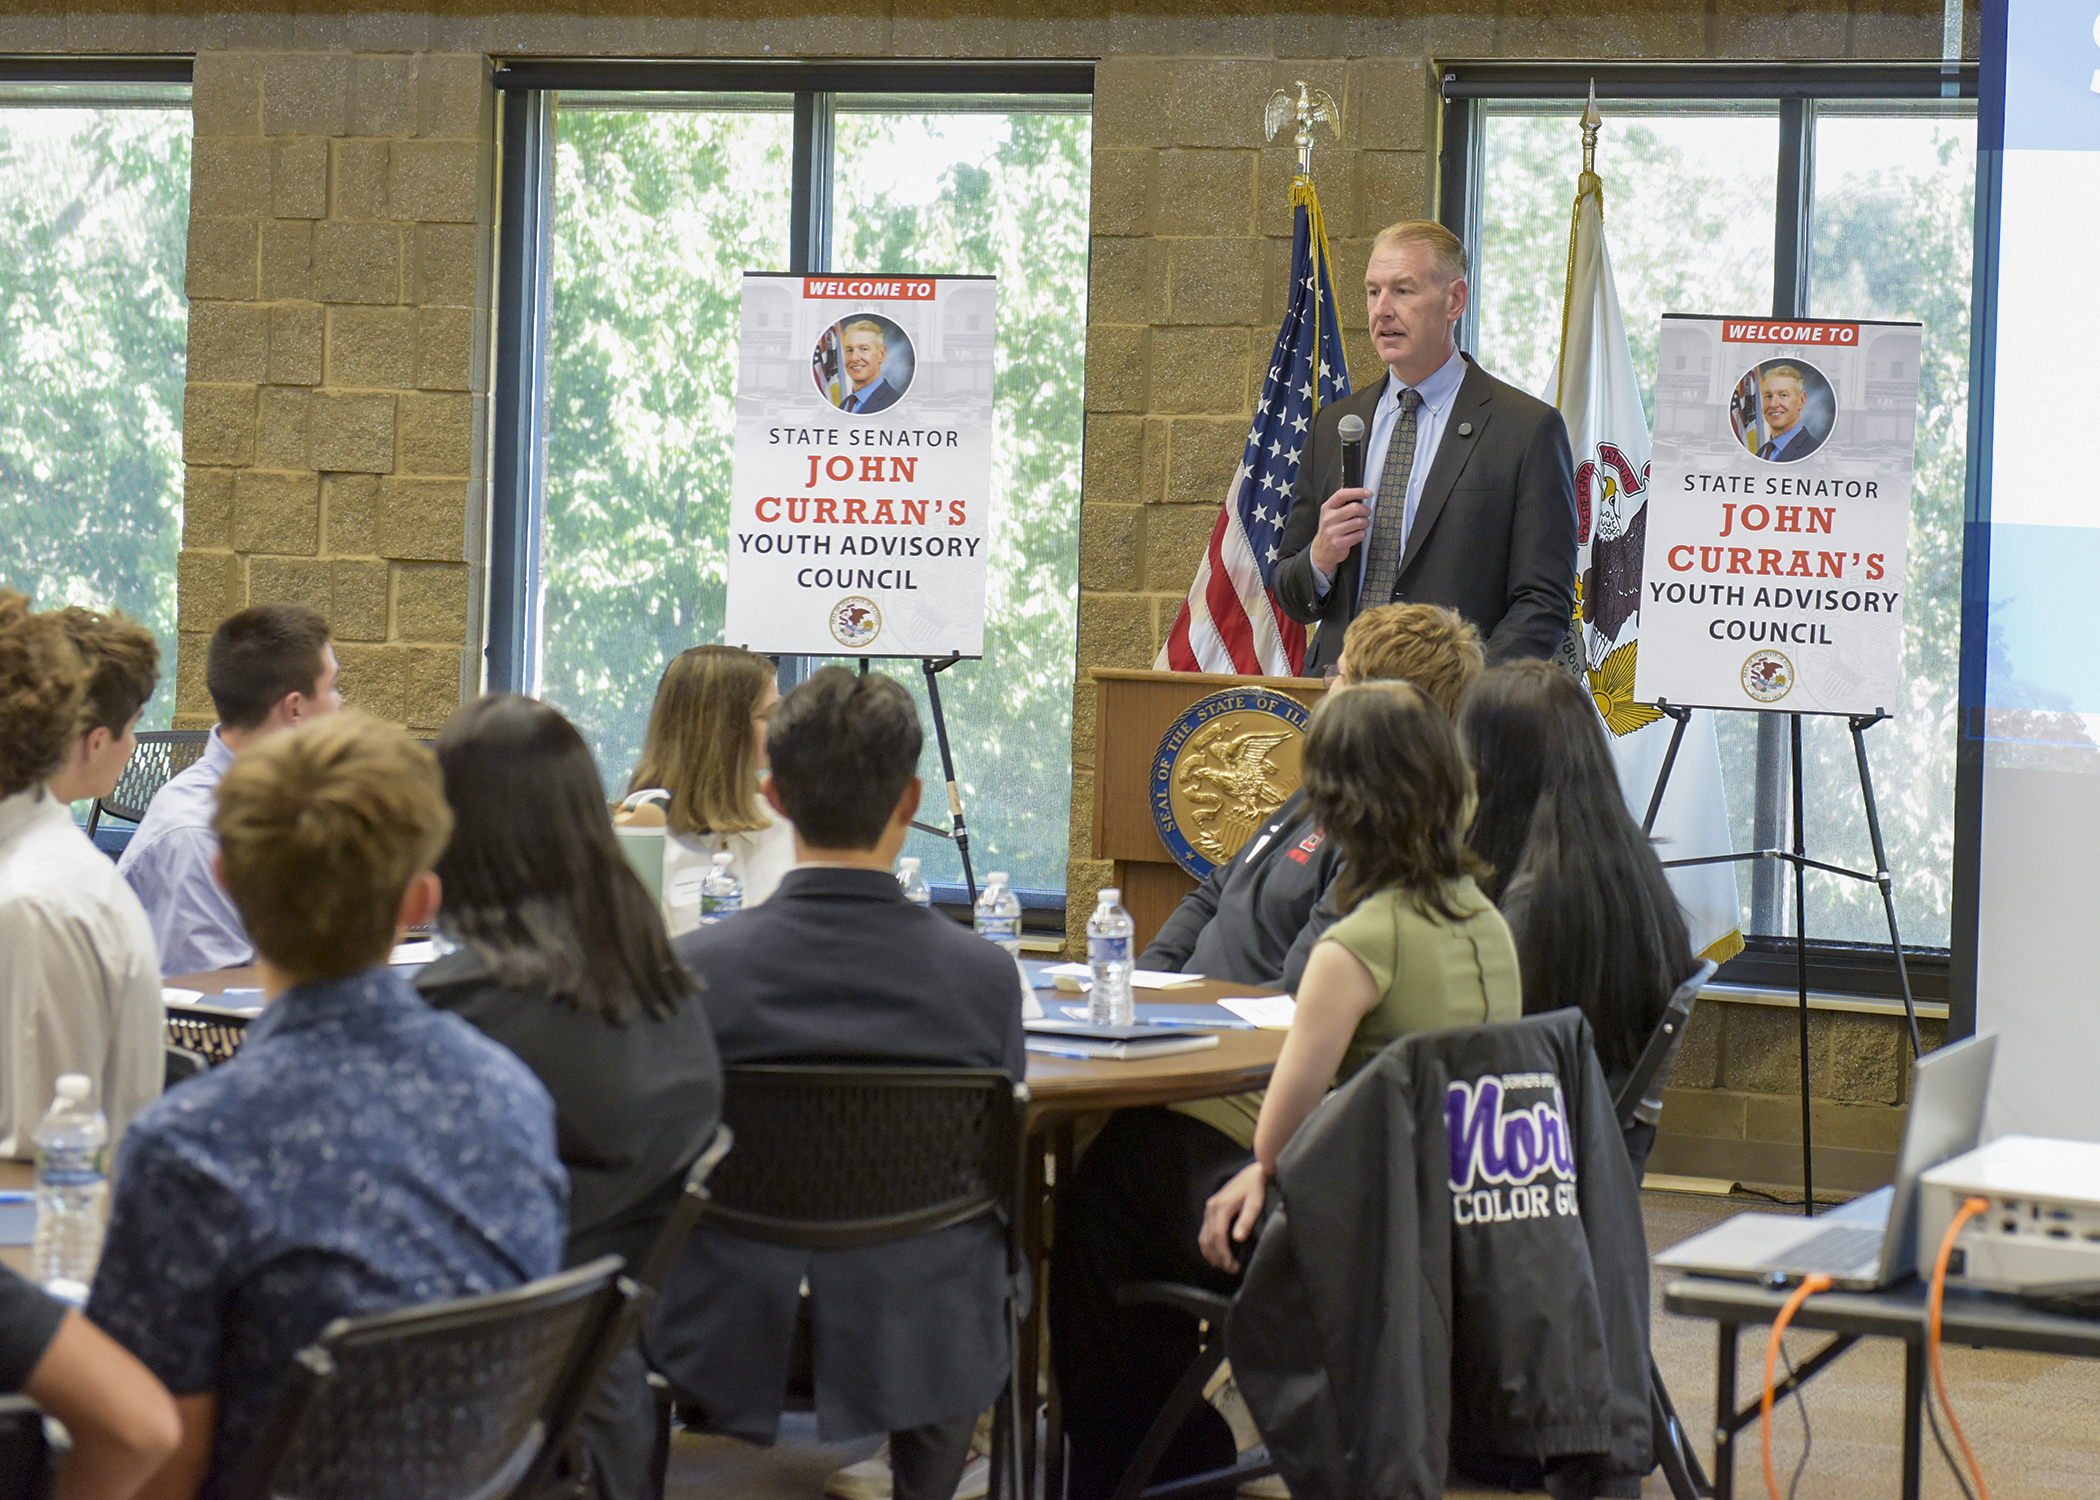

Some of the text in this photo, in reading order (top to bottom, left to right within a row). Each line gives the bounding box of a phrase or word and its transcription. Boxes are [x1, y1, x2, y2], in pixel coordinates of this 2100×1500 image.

[809, 281, 931, 297] WELCOME TO
[1728, 324, 1855, 342] WELCOME TO
[769, 428, 958, 447] STATE SENATOR
[805, 455, 918, 488] JOHN
[1683, 475, 1878, 499] STATE SENATOR
[755, 496, 966, 526] CURRAN'S
[1578, 464, 1594, 541] SOVEREIGNTY
[1719, 503, 1836, 537] JOHN
[738, 534, 980, 557] YOUTH ADVISORY
[1667, 544, 1885, 580] CURRAN'S
[797, 568, 918, 590] COUNCIL
[1650, 582, 1899, 613] YOUTH ADVISORY
[1709, 619, 1832, 645] COUNCIL
[1197, 697, 1246, 721] STATE
[1257, 698, 1279, 711] OF
[1285, 708, 1308, 731] ILL
[1166, 722, 1193, 752] THE
[1157, 759, 1172, 781] OF
[1157, 788, 1176, 833] SEAL
[1453, 1183, 1578, 1225] COLOR GU
